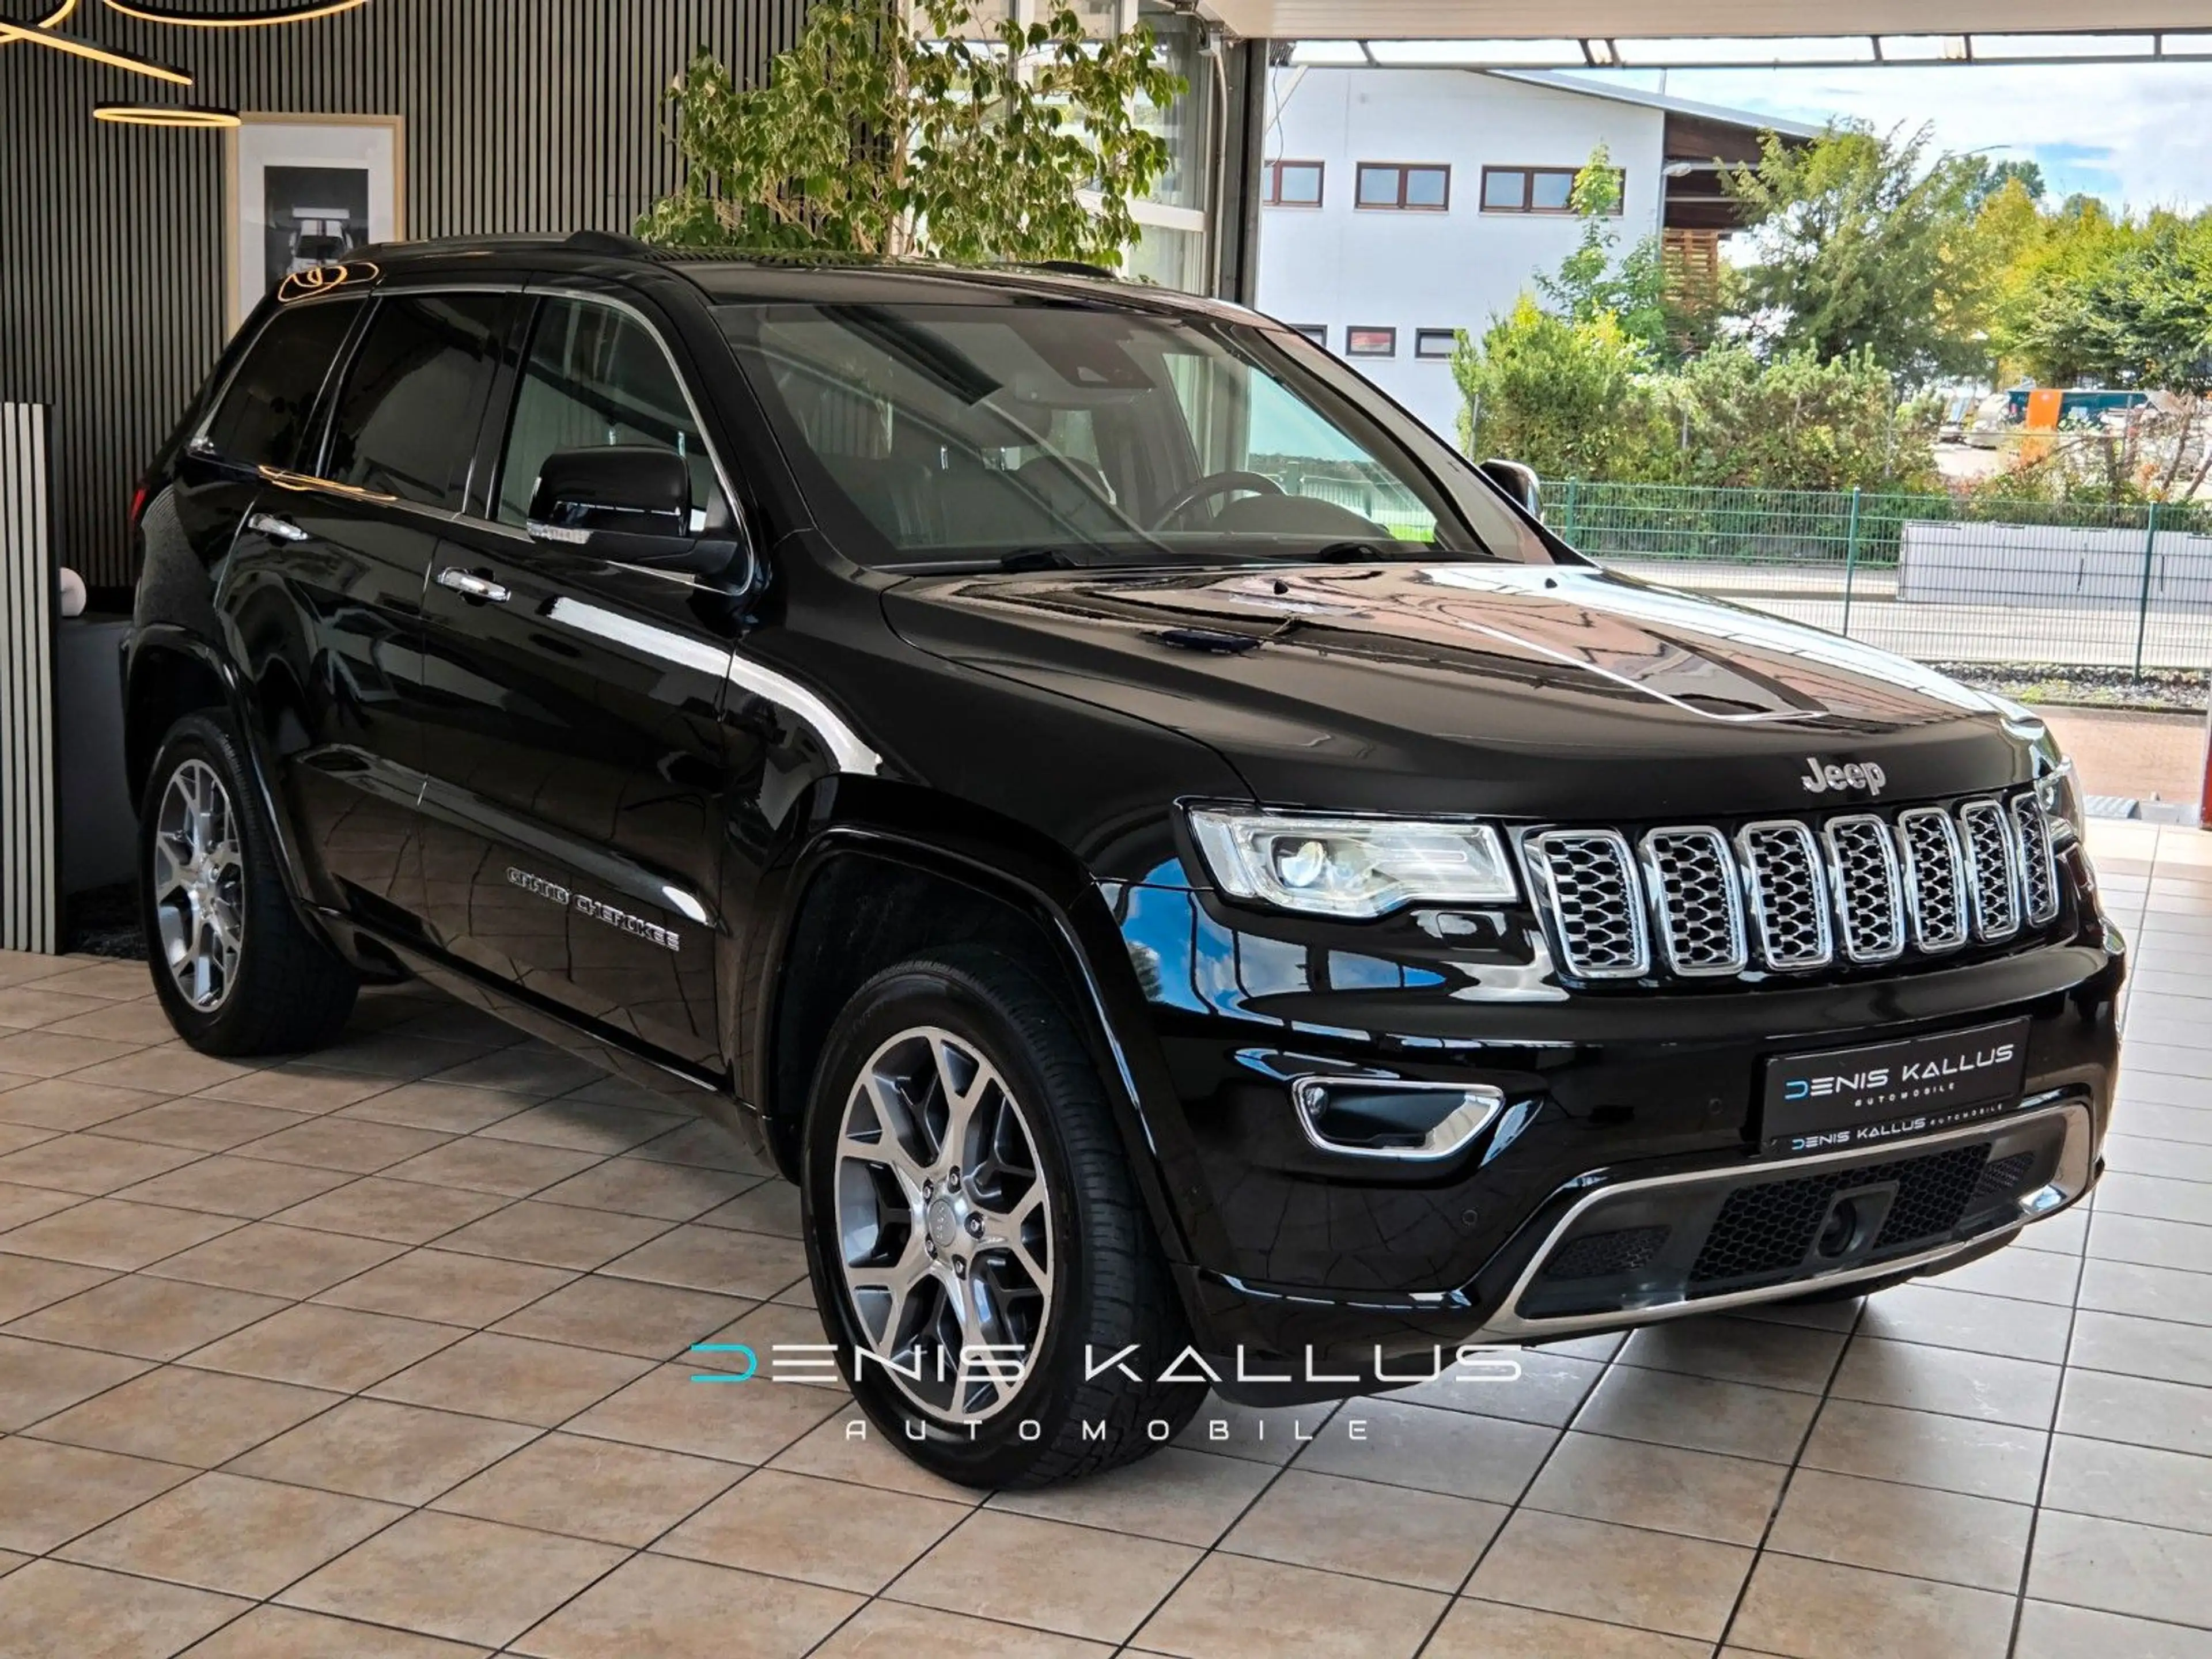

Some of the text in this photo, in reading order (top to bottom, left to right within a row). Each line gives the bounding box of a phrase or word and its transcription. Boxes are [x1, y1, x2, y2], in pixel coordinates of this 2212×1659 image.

[1801, 757, 1887, 796] Jeep
[506, 866, 680, 952] GRAND CHEROKEE
[1785, 1043, 2014, 1100] DENIS KALLUS
[1855, 1082, 1955, 1107] AUTOMOBILE
[1791, 1103, 2003, 1150] DENIS KALLUS AUTOMOBILE
